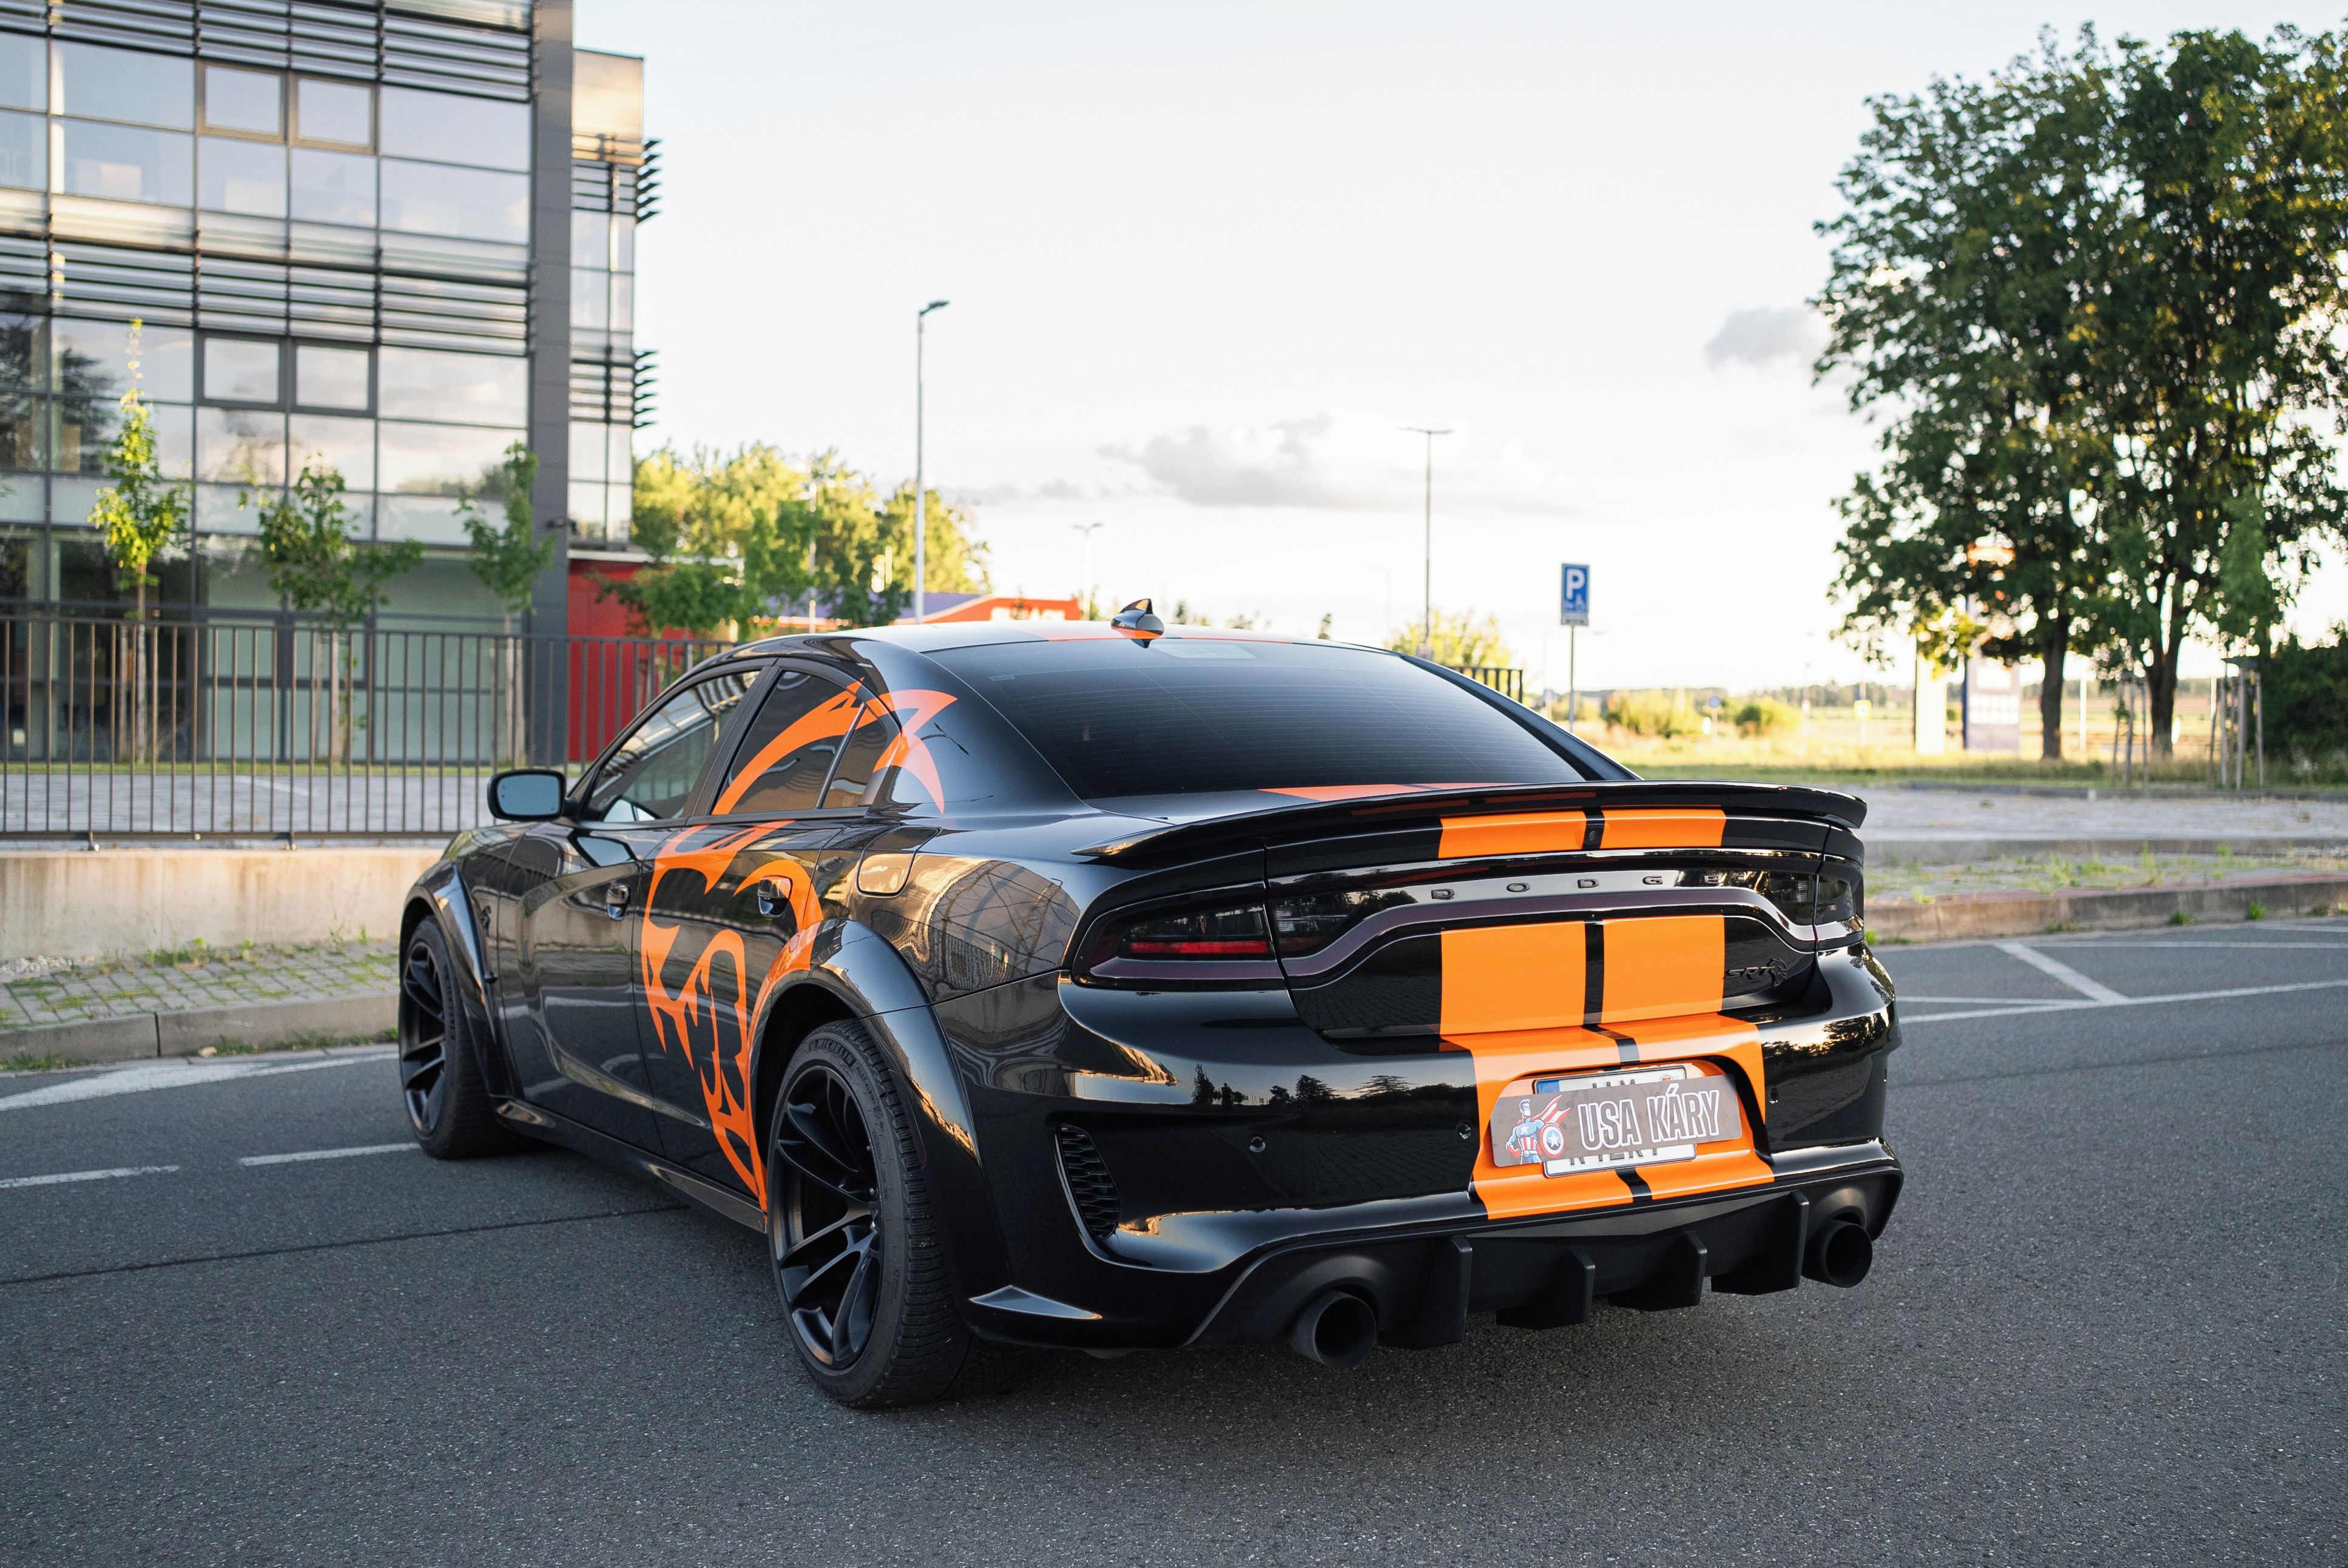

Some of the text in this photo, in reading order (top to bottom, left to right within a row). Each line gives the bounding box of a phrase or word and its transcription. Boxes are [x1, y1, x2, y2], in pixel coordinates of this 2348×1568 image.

[1566, 568, 1585, 600] P
[1431, 875, 1719, 901] DODGE
[816, 1038, 855, 1066] MICHELIN
[1577, 1083, 1719, 1151] USA KÁRY
